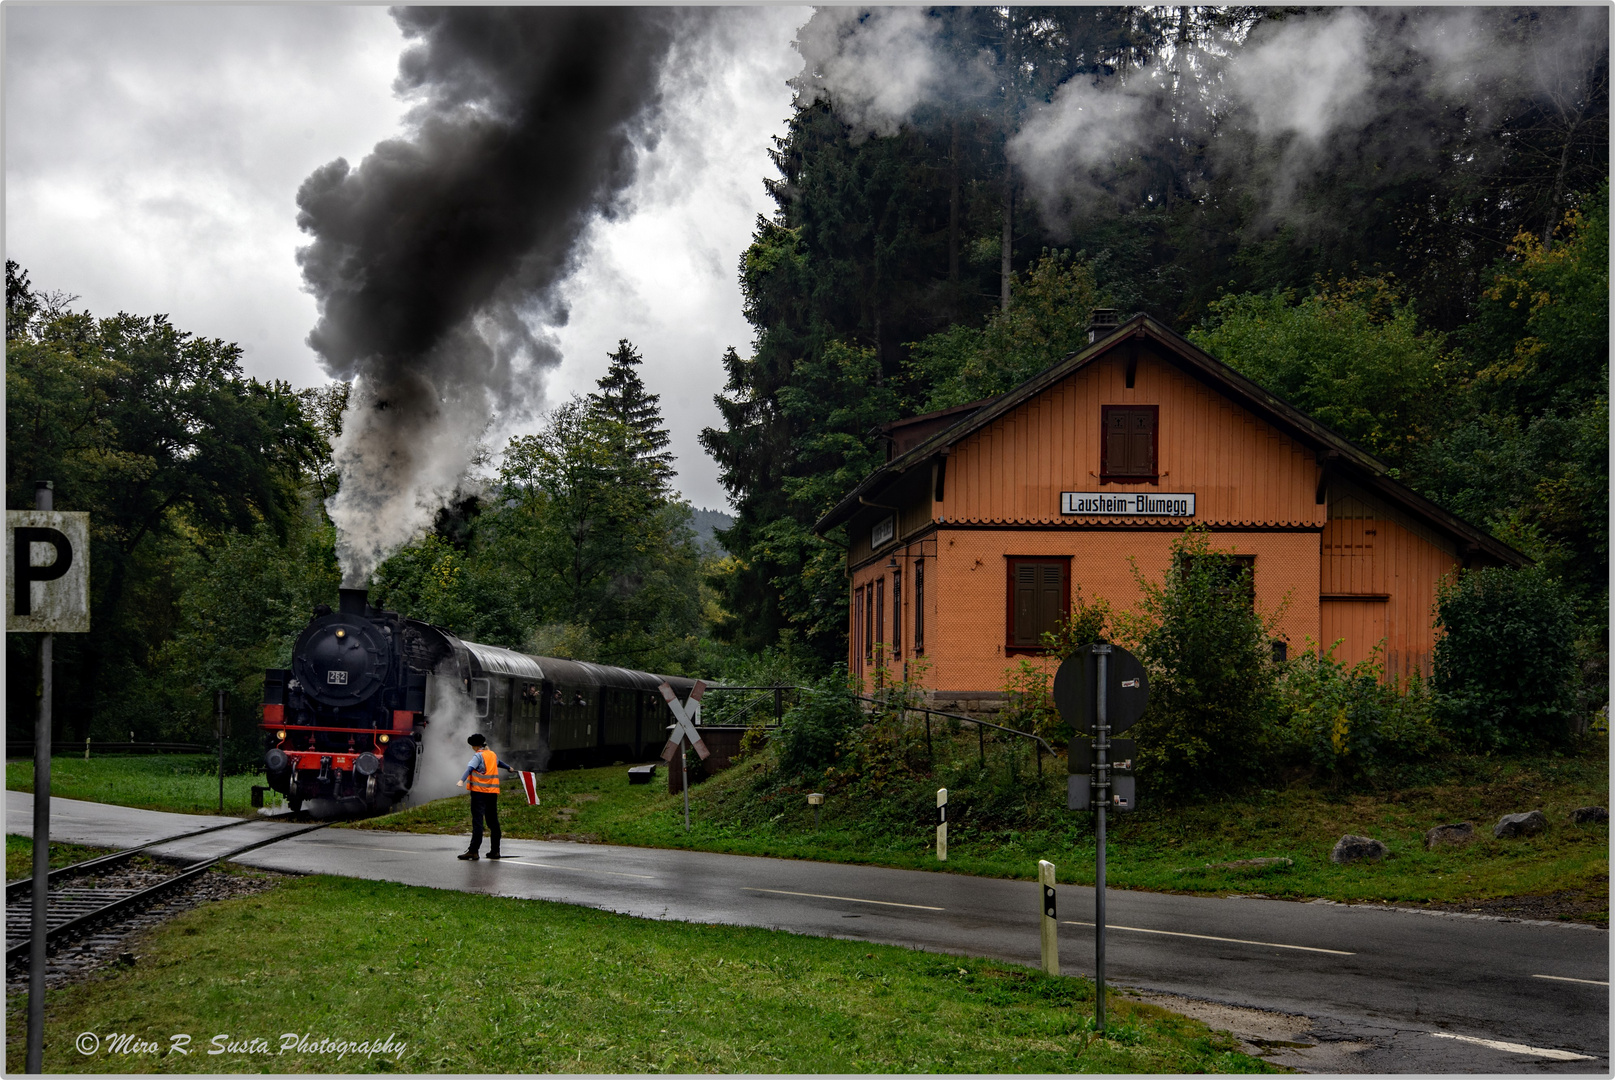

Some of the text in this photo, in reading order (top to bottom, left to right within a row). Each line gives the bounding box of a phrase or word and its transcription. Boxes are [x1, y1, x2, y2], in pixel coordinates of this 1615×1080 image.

[1069, 494, 1187, 516] Lausheim-Blumegg
[14, 527, 73, 615] P
[330, 671, 346, 680] 262
